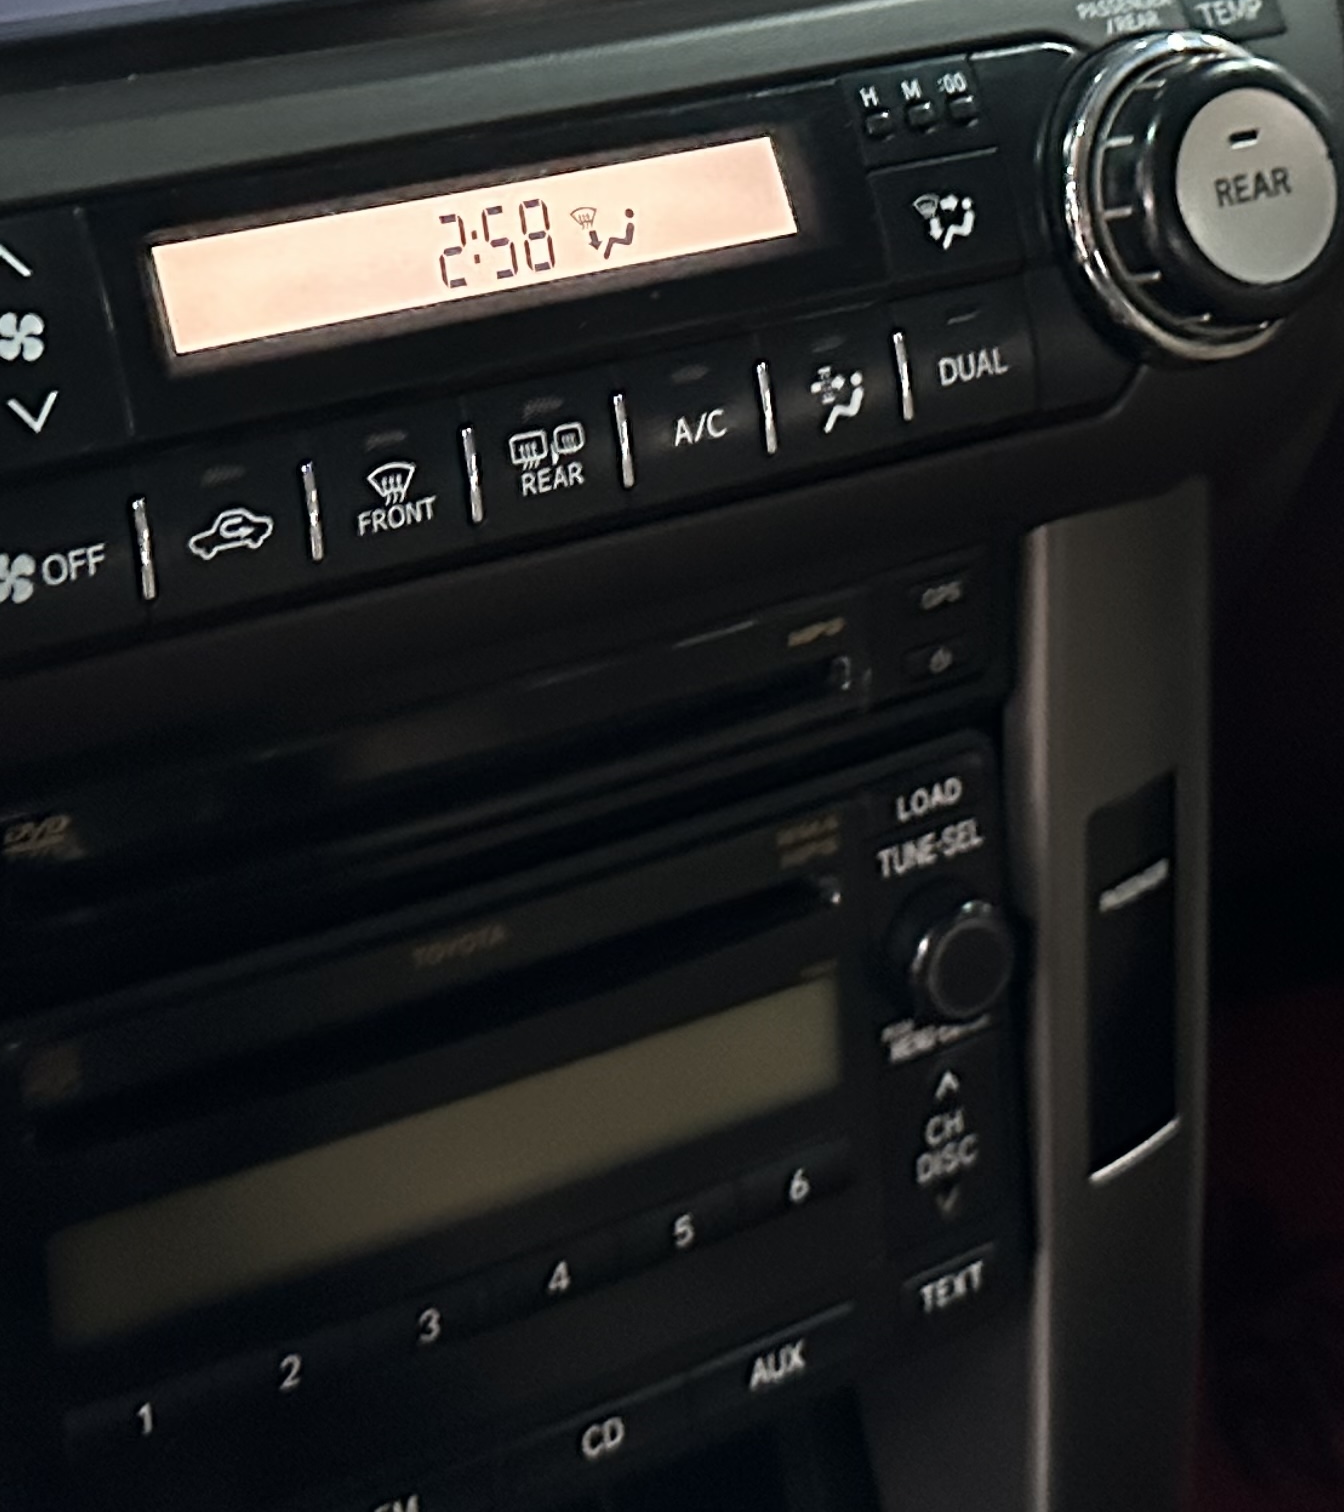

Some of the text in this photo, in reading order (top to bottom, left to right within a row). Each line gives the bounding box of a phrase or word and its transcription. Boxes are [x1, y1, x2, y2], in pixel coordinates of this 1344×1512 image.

[859, 85, 880, 107] H
[900, 78, 922, 100] M
[1213, 169, 1291, 208] REAR
[438, 198, 556, 288] 2:58
[938, 348, 1009, 387] DUAL
[673, 408, 728, 447] A/C
[521, 462, 584, 498] REAR
[358, 495, 436, 537] FRONT
[42, 542, 106, 586] OFF
[895, 776, 963, 823] LOAD
[924, 1107, 965, 1148] CH
[916, 1131, 980, 1186] DISC
[137, 1167, 811, 1435] 1 2 3 4 5 6
[919, 1260, 986, 1314] TEXT
[748, 1339, 807, 1393] AUX
[580, 1416, 626, 1461] CD
